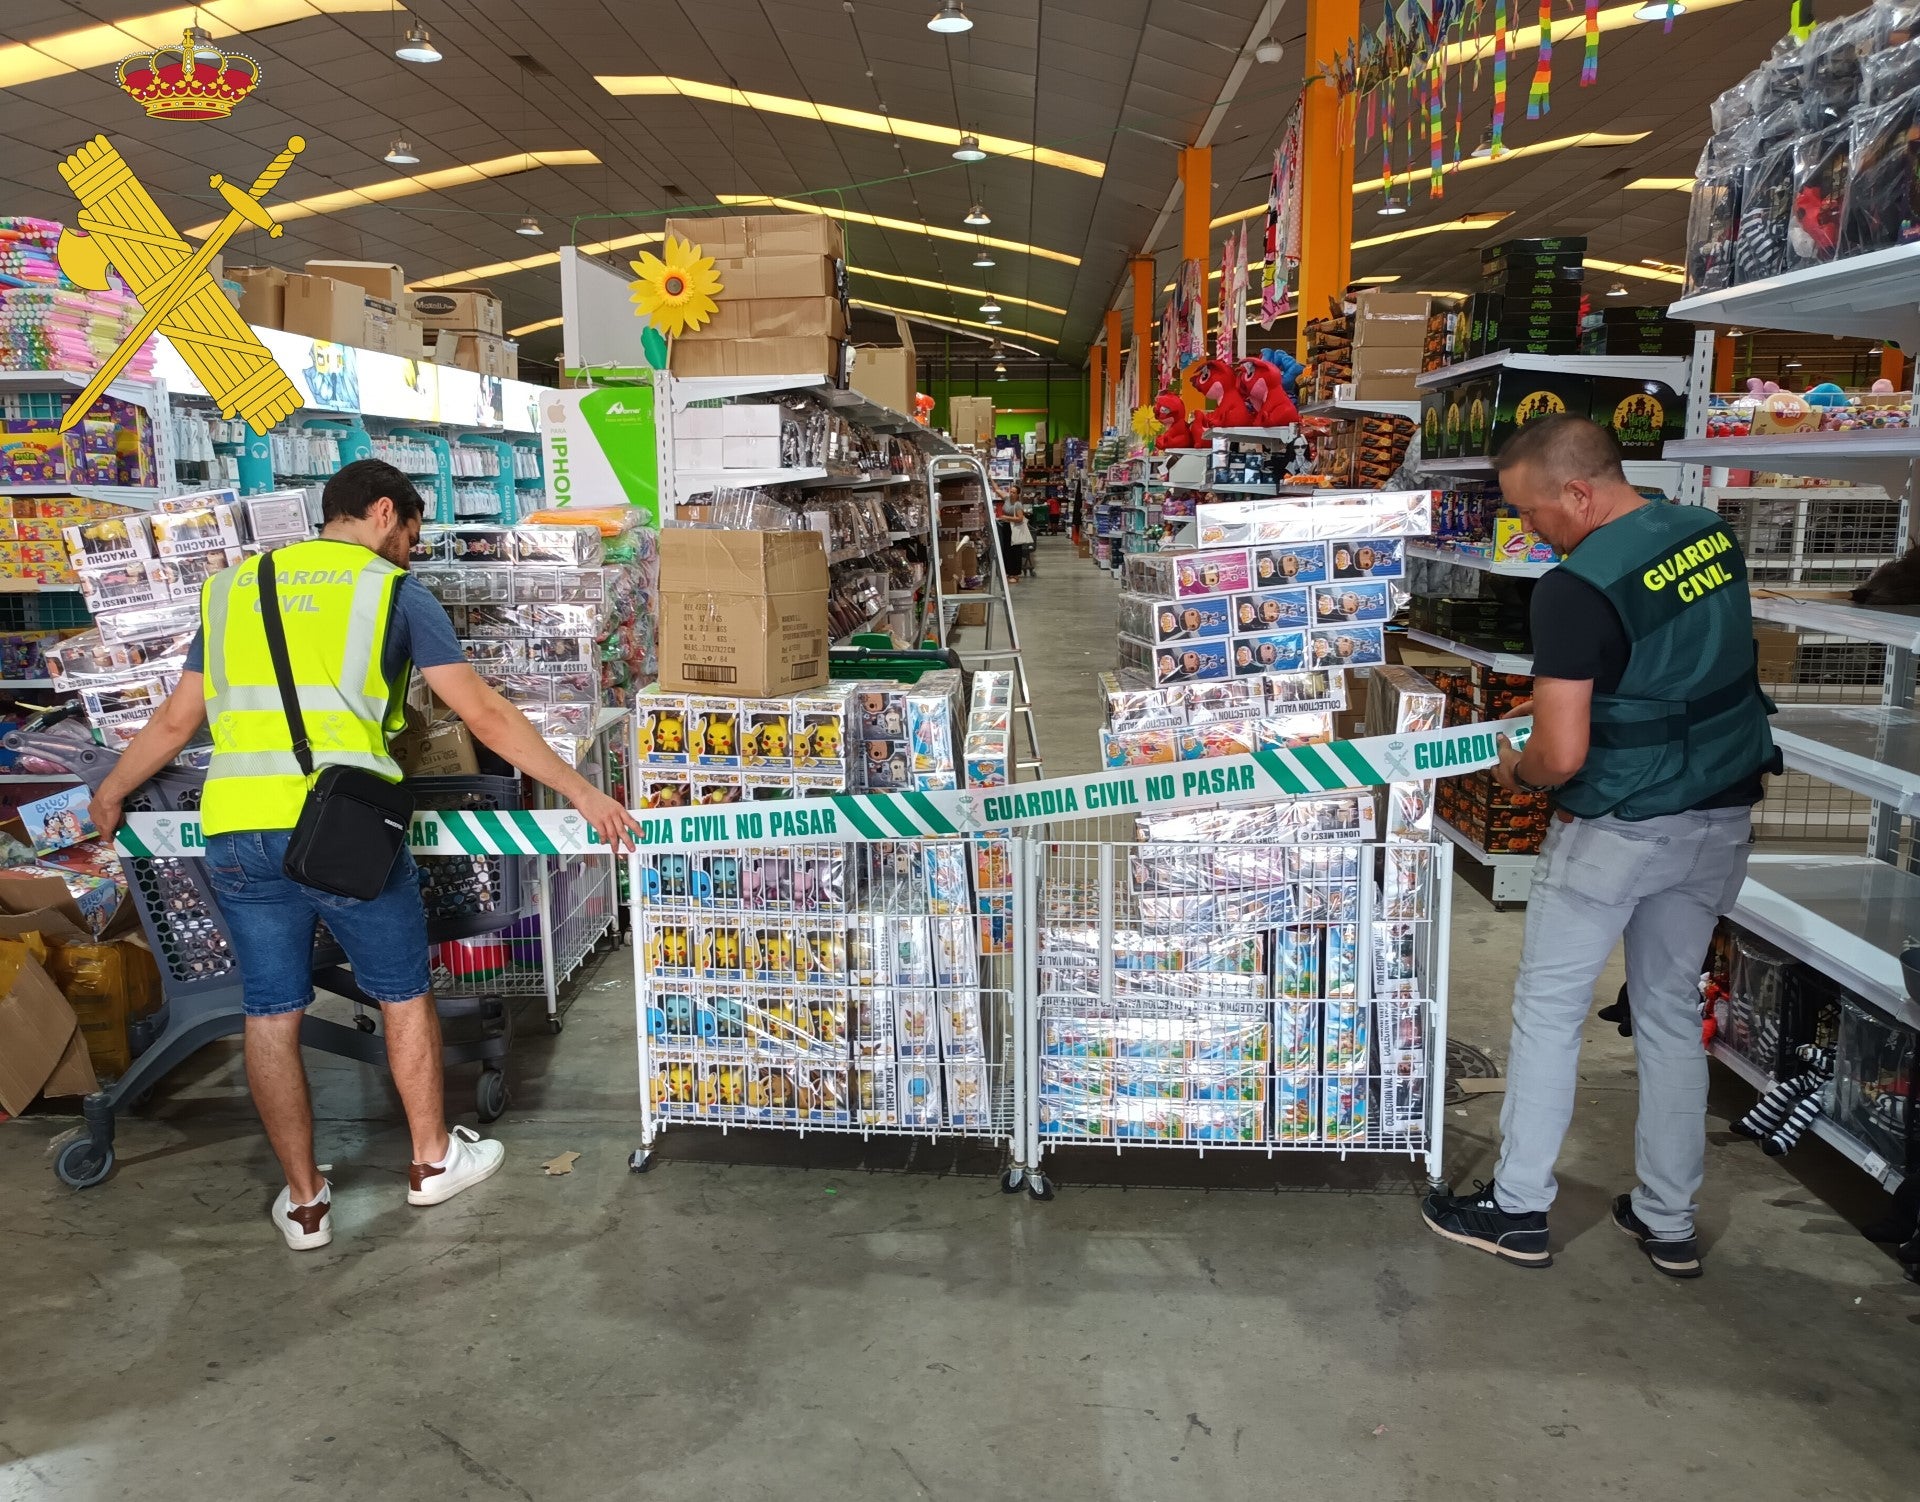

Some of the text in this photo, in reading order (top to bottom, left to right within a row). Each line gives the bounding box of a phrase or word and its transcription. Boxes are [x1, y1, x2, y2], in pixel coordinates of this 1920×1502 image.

[174, 537, 226, 553] PIKACHU
[86, 549, 138, 566] PIKACHU
[1643, 531, 1733, 591] GUARDIA
[236, 569, 353, 588] GARDIA
[1677, 562, 1733, 603] CIVIL
[101, 592, 154, 609] LIONEL MESSI
[253, 594, 320, 613] CVIL
[1218, 707, 1261, 722] COLLECTION
[1274, 698, 1341, 714] COLLECTION VALUE
[1414, 732, 1504, 770] GUARDI
[983, 764, 1256, 822] GUARDIA CIVIL NO PASAR
[681, 814, 729, 843] CIVIL
[736, 812, 763, 840] NO
[769, 808, 838, 838] PASAR
[1335, 830, 1360, 839] LIONEL
[885, 1067, 896, 1112] PIKACHU
[1384, 1089, 1394, 1127] COLLECTION
